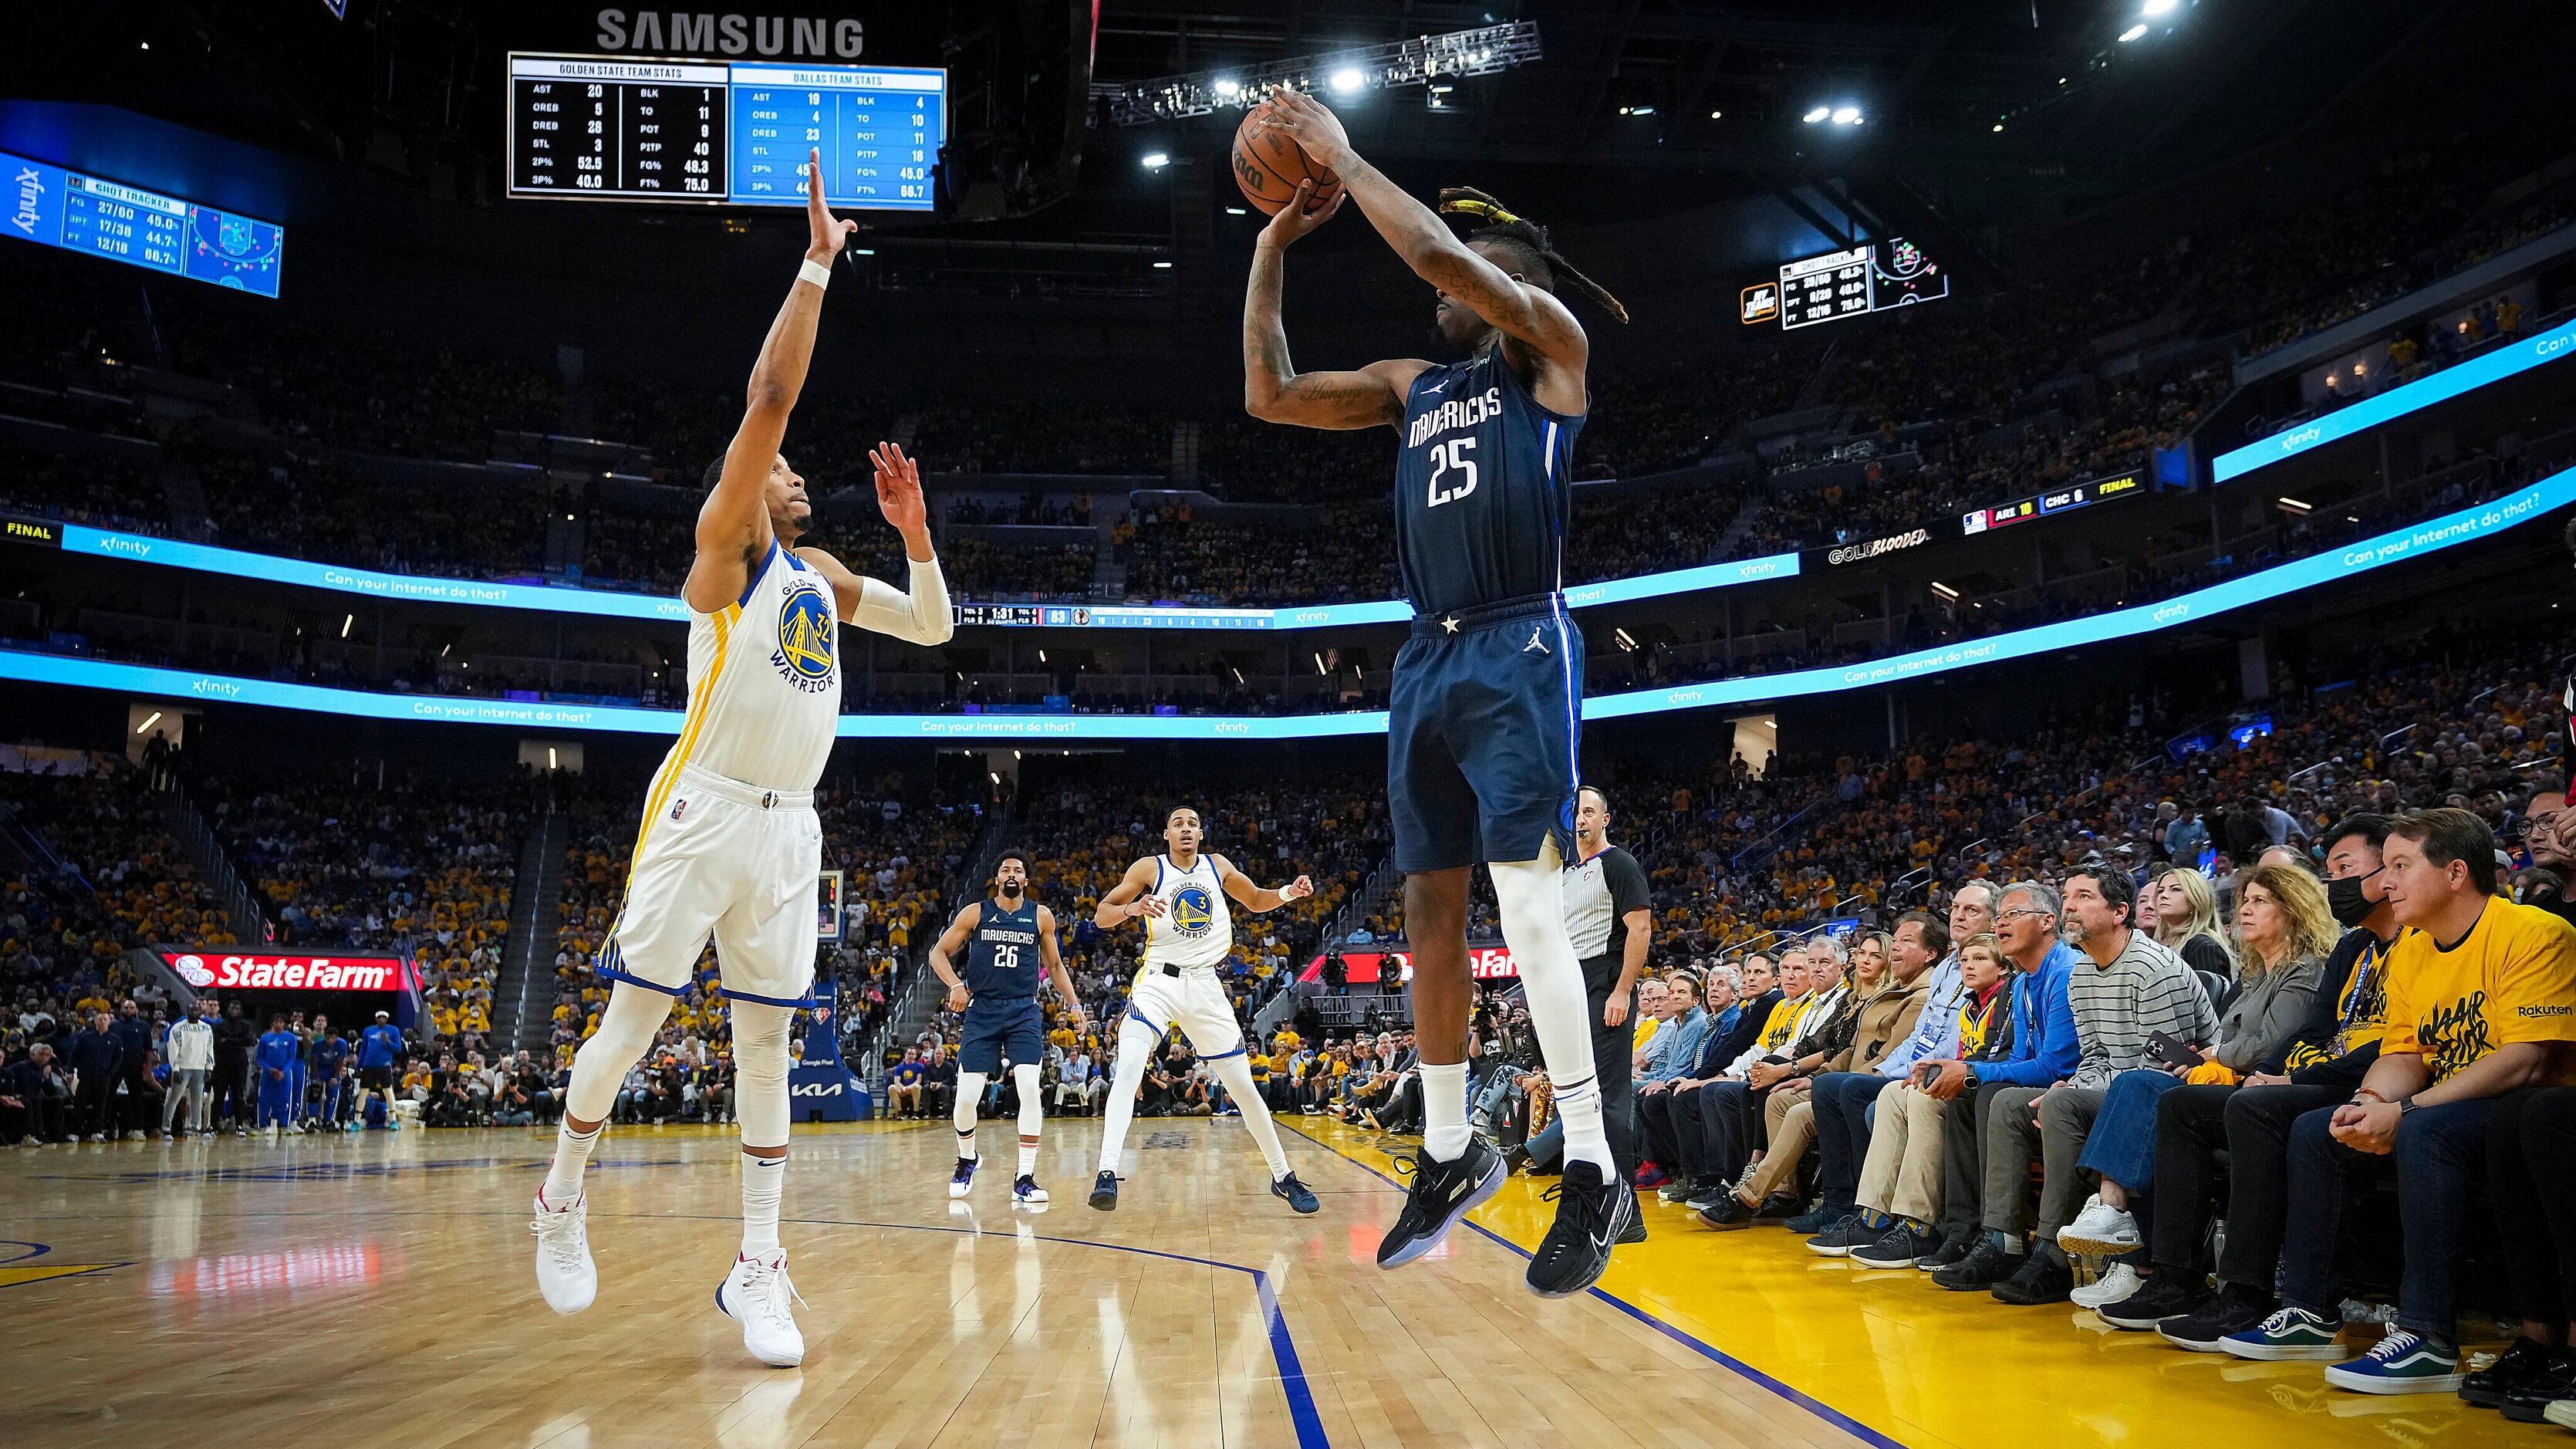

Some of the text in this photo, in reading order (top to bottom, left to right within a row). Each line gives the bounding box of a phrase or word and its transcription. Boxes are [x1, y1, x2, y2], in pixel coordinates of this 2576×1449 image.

[596, 8, 863, 58] SAMSUNG
[560, 64, 681, 78] GOLDEN STATE TEAM STATS
[794, 73, 881, 86] DALLAS TEAM STATS
[533, 84, 603, 98] AST 20
[641, 88, 709, 102] BLK 1
[753, 93, 770, 102] AST
[857, 96, 923, 109] BLK 4
[533, 103, 603, 116] OREB 5
[640, 106, 709, 120] TO 11
[753, 111, 819, 123] OREB 4
[912, 115, 923, 127] 10
[533, 121, 559, 130] DREB
[640, 125, 660, 133] POT
[752, 129, 819, 141] DREB 23
[914, 133, 923, 144] 11
[533, 139, 602, 151] STL 3
[640, 142, 708, 155] PITP 40
[752, 147, 768, 155] STL
[912, 150, 923, 162] 18
[532, 157, 602, 170] 2P% 52.5
[640, 161, 661, 170] FG%
[752, 164, 771, 174] 2P%
[857, 167, 923, 180] FG% 45.0
[532, 174, 602, 188] 3P% 40.0
[640, 177, 708, 191] FT% 75.0
[752, 183, 771, 191] 3P%
[96, 183, 170, 209] SHOT TRACKER
[857, 185, 923, 198] FT% 66.7
[12, 167, 45, 235] xfinity
[71, 197, 84, 208] FG
[98, 201, 133, 220] 27/60
[67, 231, 80, 242] FT
[2537, 336, 2568, 354] Can
[1408, 387, 1502, 449] MAVERICKS
[2281, 427, 2321, 450] xfinity
[1427, 437, 1477, 508] 25
[1996, 478, 2135, 521] ARI 10 CHC 6 FINAL
[8, 522, 52, 539] FINAL
[2345, 493, 2539, 566] Can your Internet do that?
[100, 536, 150, 556] xfinity
[1740, 562, 1775, 577] xfinity
[324, 571, 507, 600] Can your Internet do that?
[1578, 588, 1605, 600] that?
[992, 608, 1012, 620] 1:31
[1296, 611, 1329, 623] xfinity
[2152, 604, 2189, 623] xfinity
[815, 613, 829, 643] 32
[1143, 617, 1151, 626] 23
[1845, 643, 1996, 682] Can your Internet do that?
[193, 679, 240, 697] xfinity
[1668, 691, 1703, 704] xfinity
[413, 703, 592, 723] Can your Internet do that?
[921, 721, 1075, 733] Can your Internet do that?
[1214, 722, 1249, 733] xfinity
[1170, 882, 1211, 897] GOLDEN STATE
[1198, 897, 1207, 909] 3
[1173, 922, 1213, 938] WARRIORS
[981, 930, 1034, 944] MAVERICKS
[994, 944, 1018, 968] 26
[2358, 963, 2367, 987] CHASE
[2518, 1005, 2573, 1016] Rakuten
